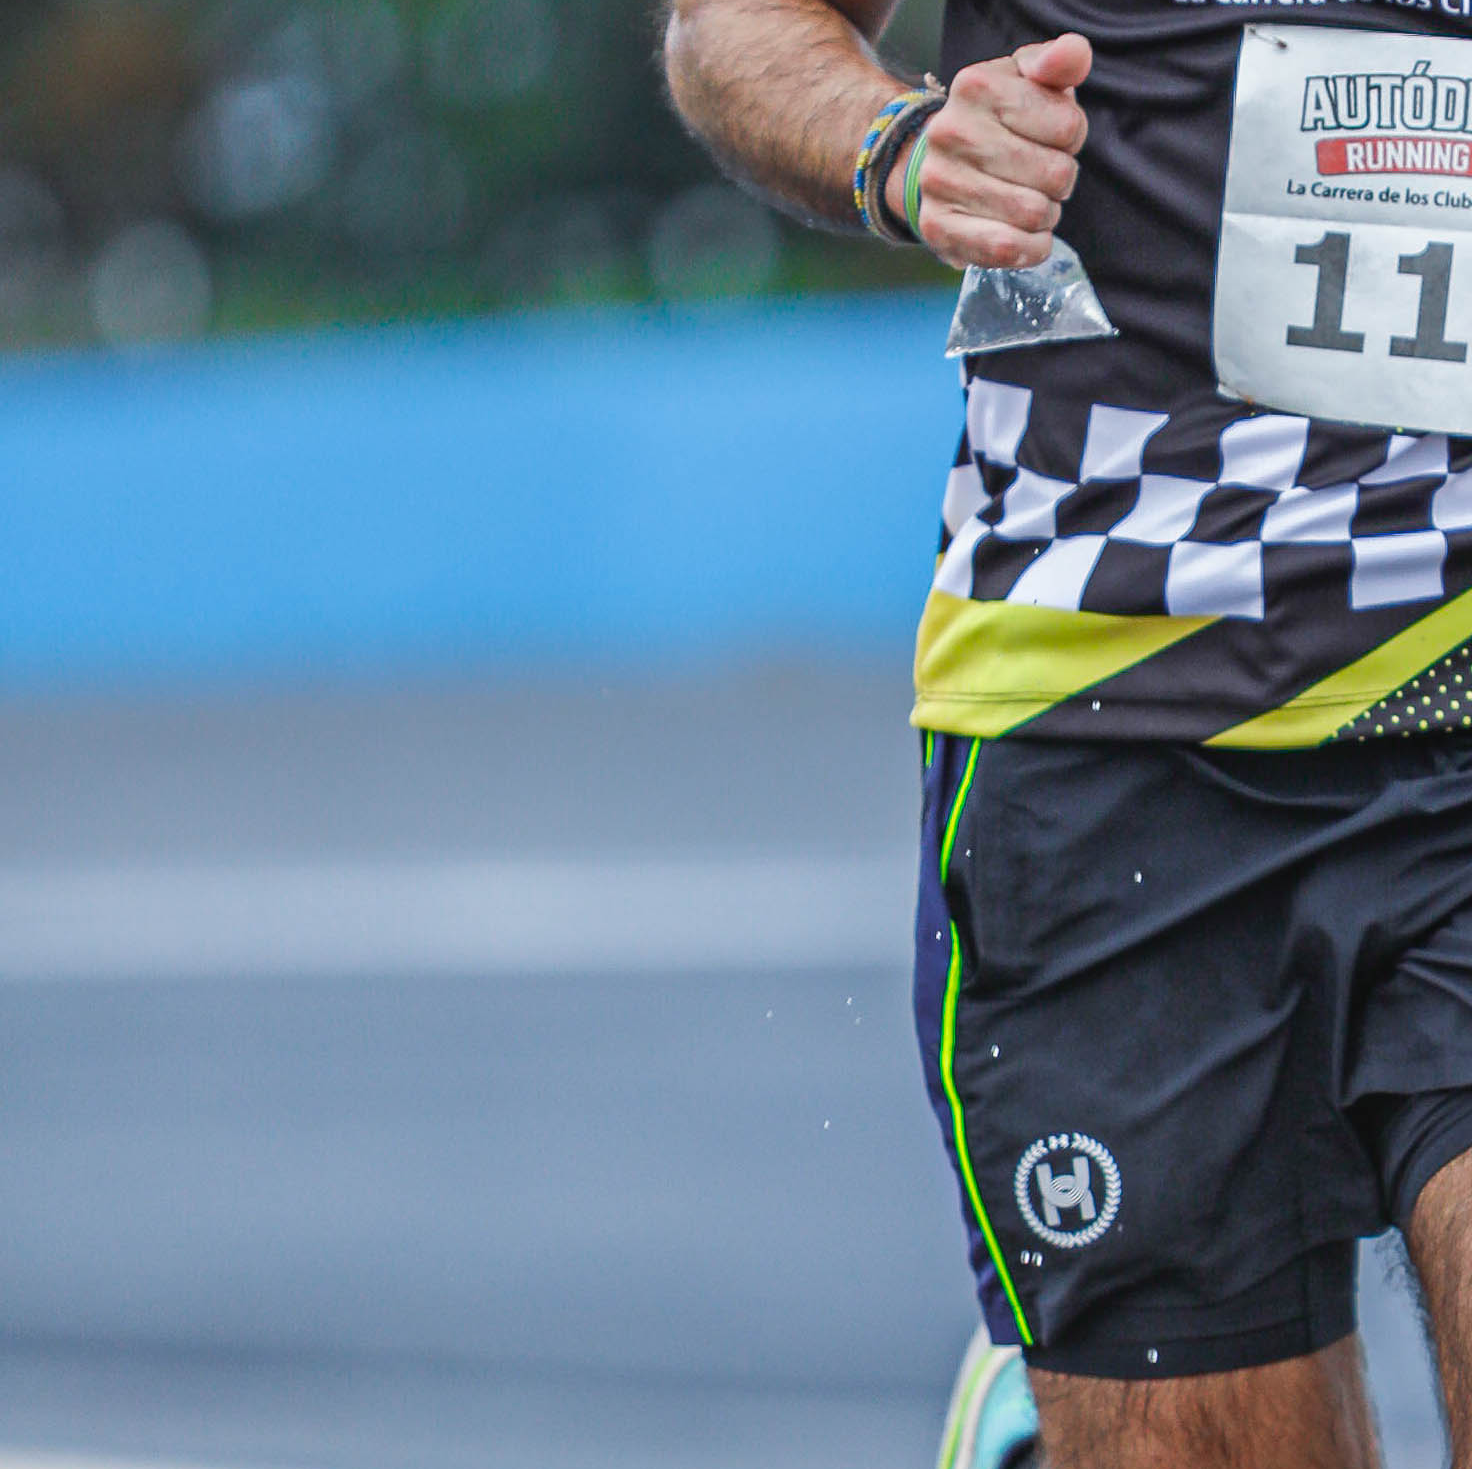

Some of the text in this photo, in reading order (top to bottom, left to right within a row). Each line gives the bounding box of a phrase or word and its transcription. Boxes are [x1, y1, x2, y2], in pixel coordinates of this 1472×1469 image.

[1345, 141, 1470, 173] RUNNING
[1286, 178, 1306, 195] La
[1311, 181, 1374, 201] Carrera
[1378, 187, 1400, 202] de
[1405, 187, 1429, 205] los
